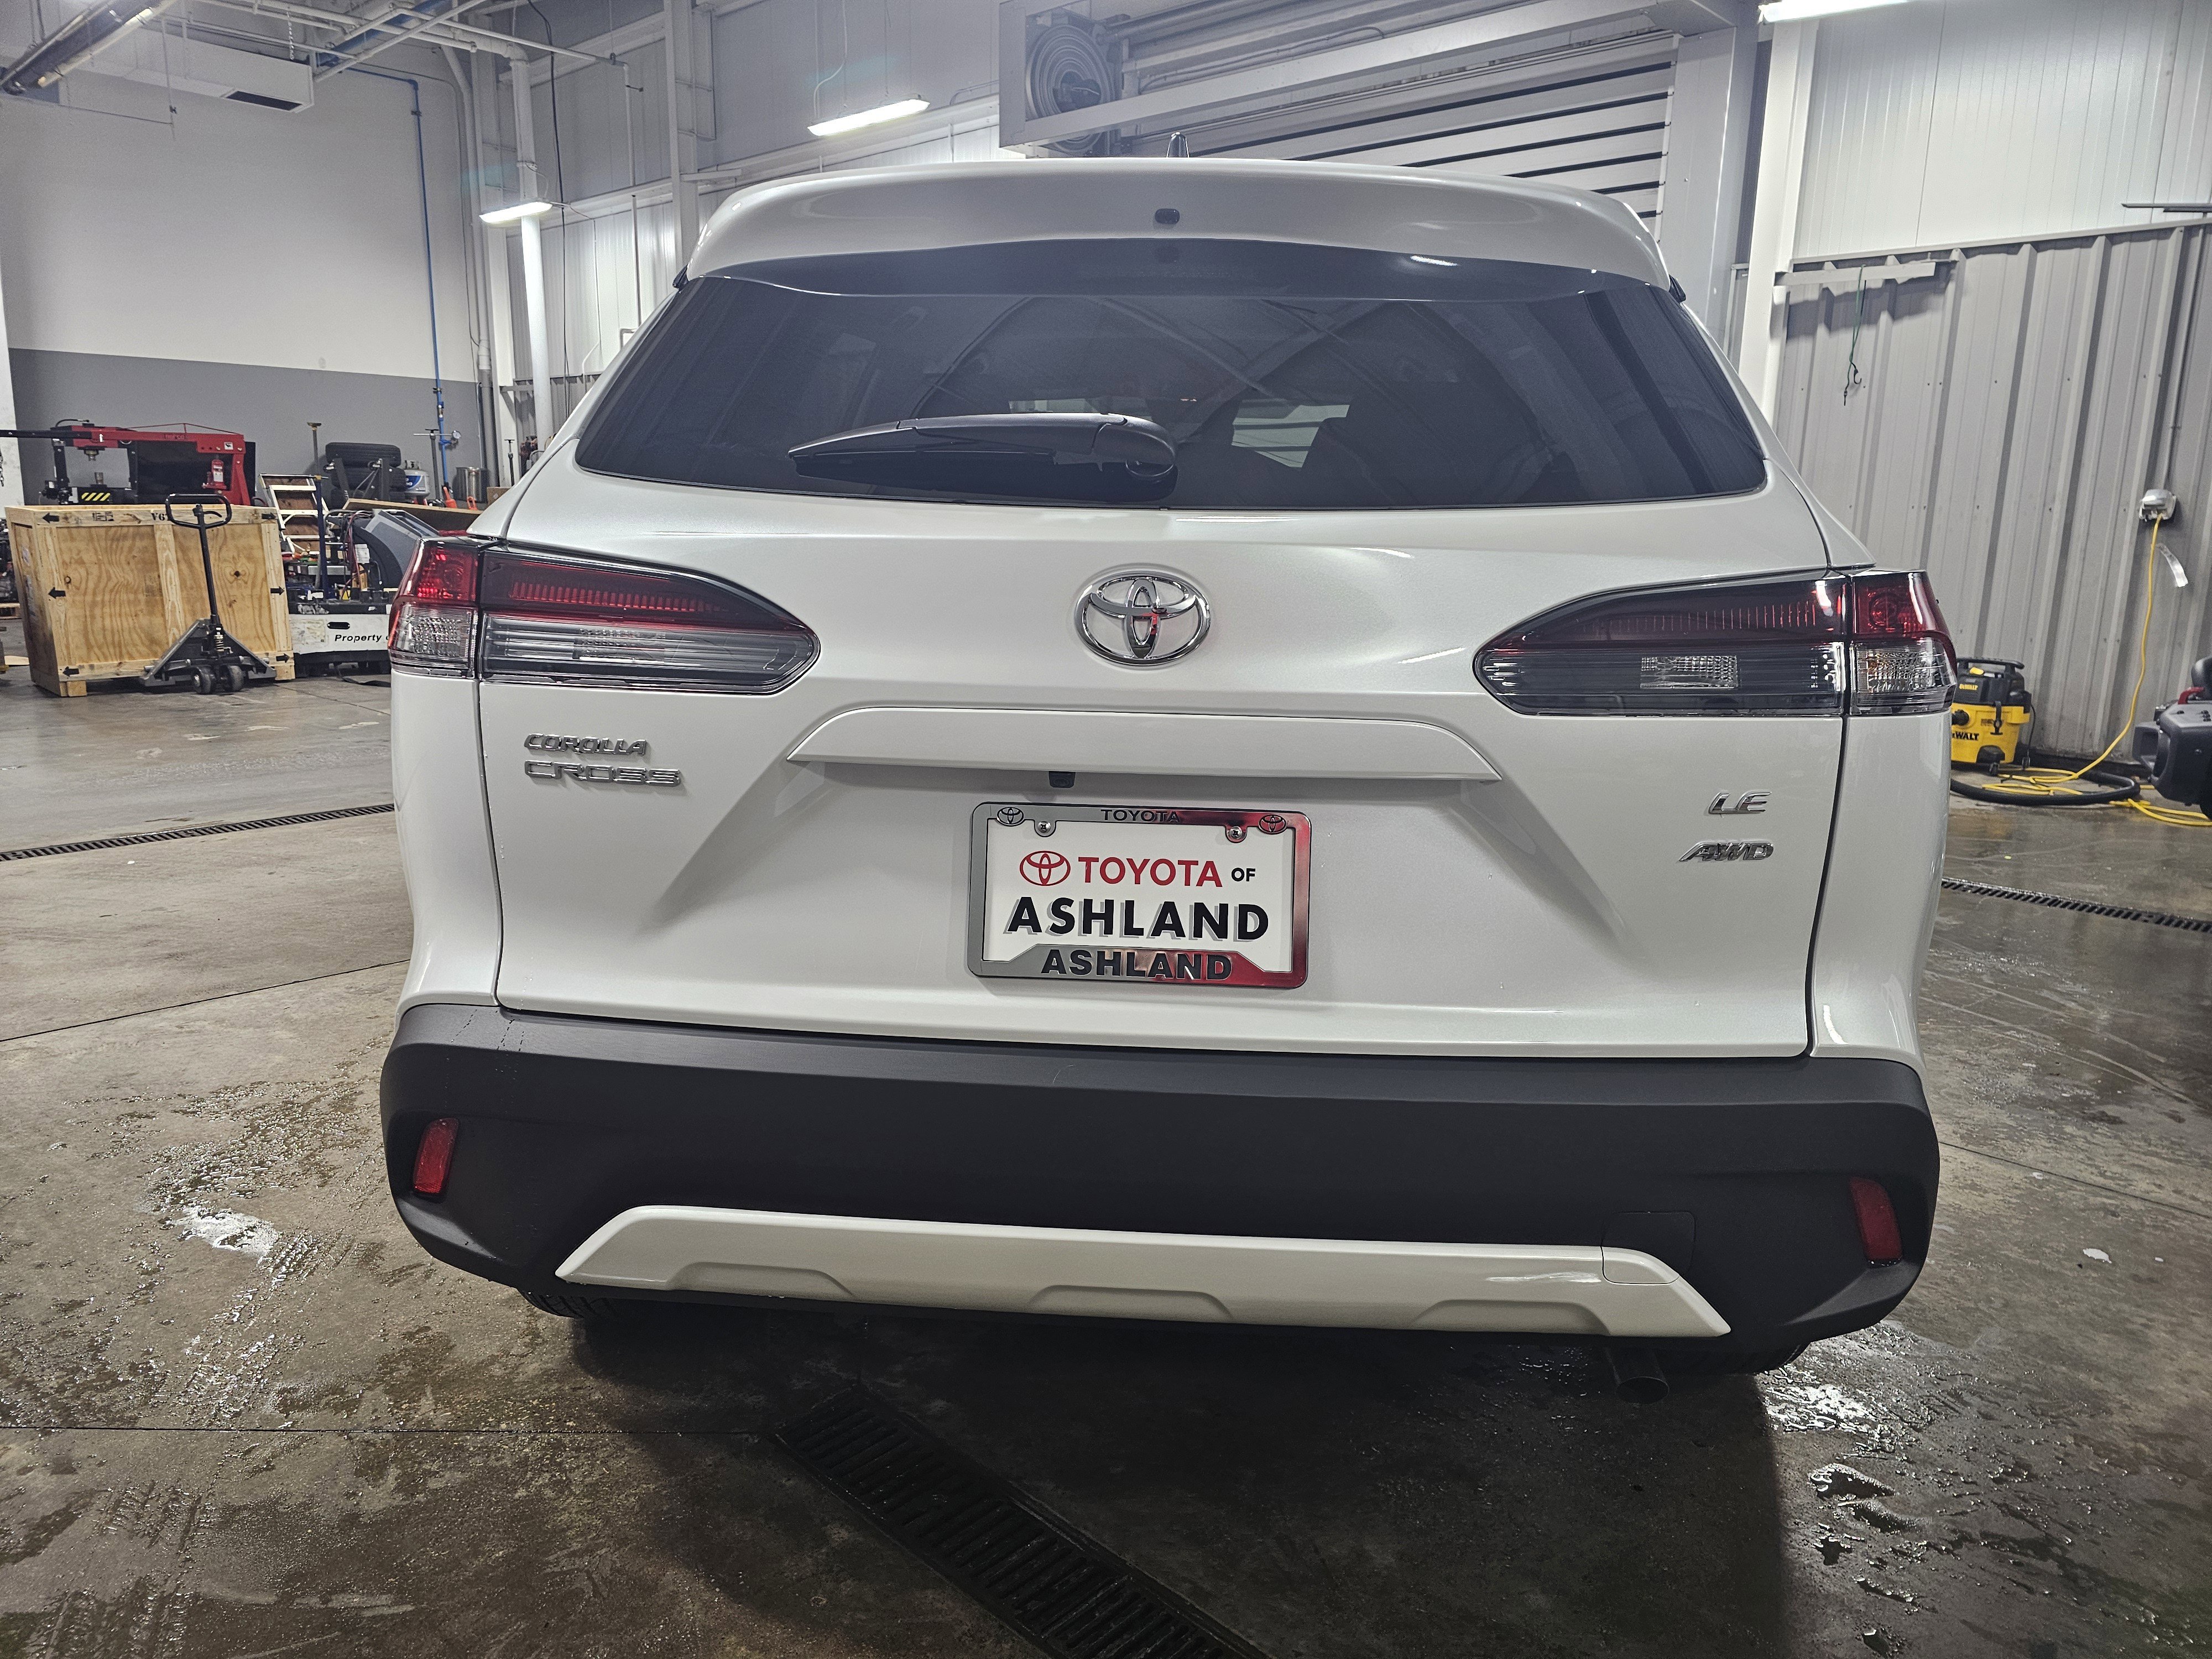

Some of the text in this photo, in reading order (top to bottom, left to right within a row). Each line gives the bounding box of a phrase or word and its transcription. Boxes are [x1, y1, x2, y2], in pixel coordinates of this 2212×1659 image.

[151, 513, 170, 521] V6
[335, 634, 382, 643] Property
[524, 733, 646, 755] COROLLA
[1952, 731, 1979, 741] EWALT
[524, 760, 681, 787] CROSS
[1708, 791, 1772, 815] LE
[1100, 809, 1180, 823] TOYOTA
[1679, 841, 1774, 862] AWD
[1078, 857, 1256, 887] TOYOTA OF
[1005, 896, 1269, 941] ASHLAND
[1041, 949, 1232, 980] ASHLAND
